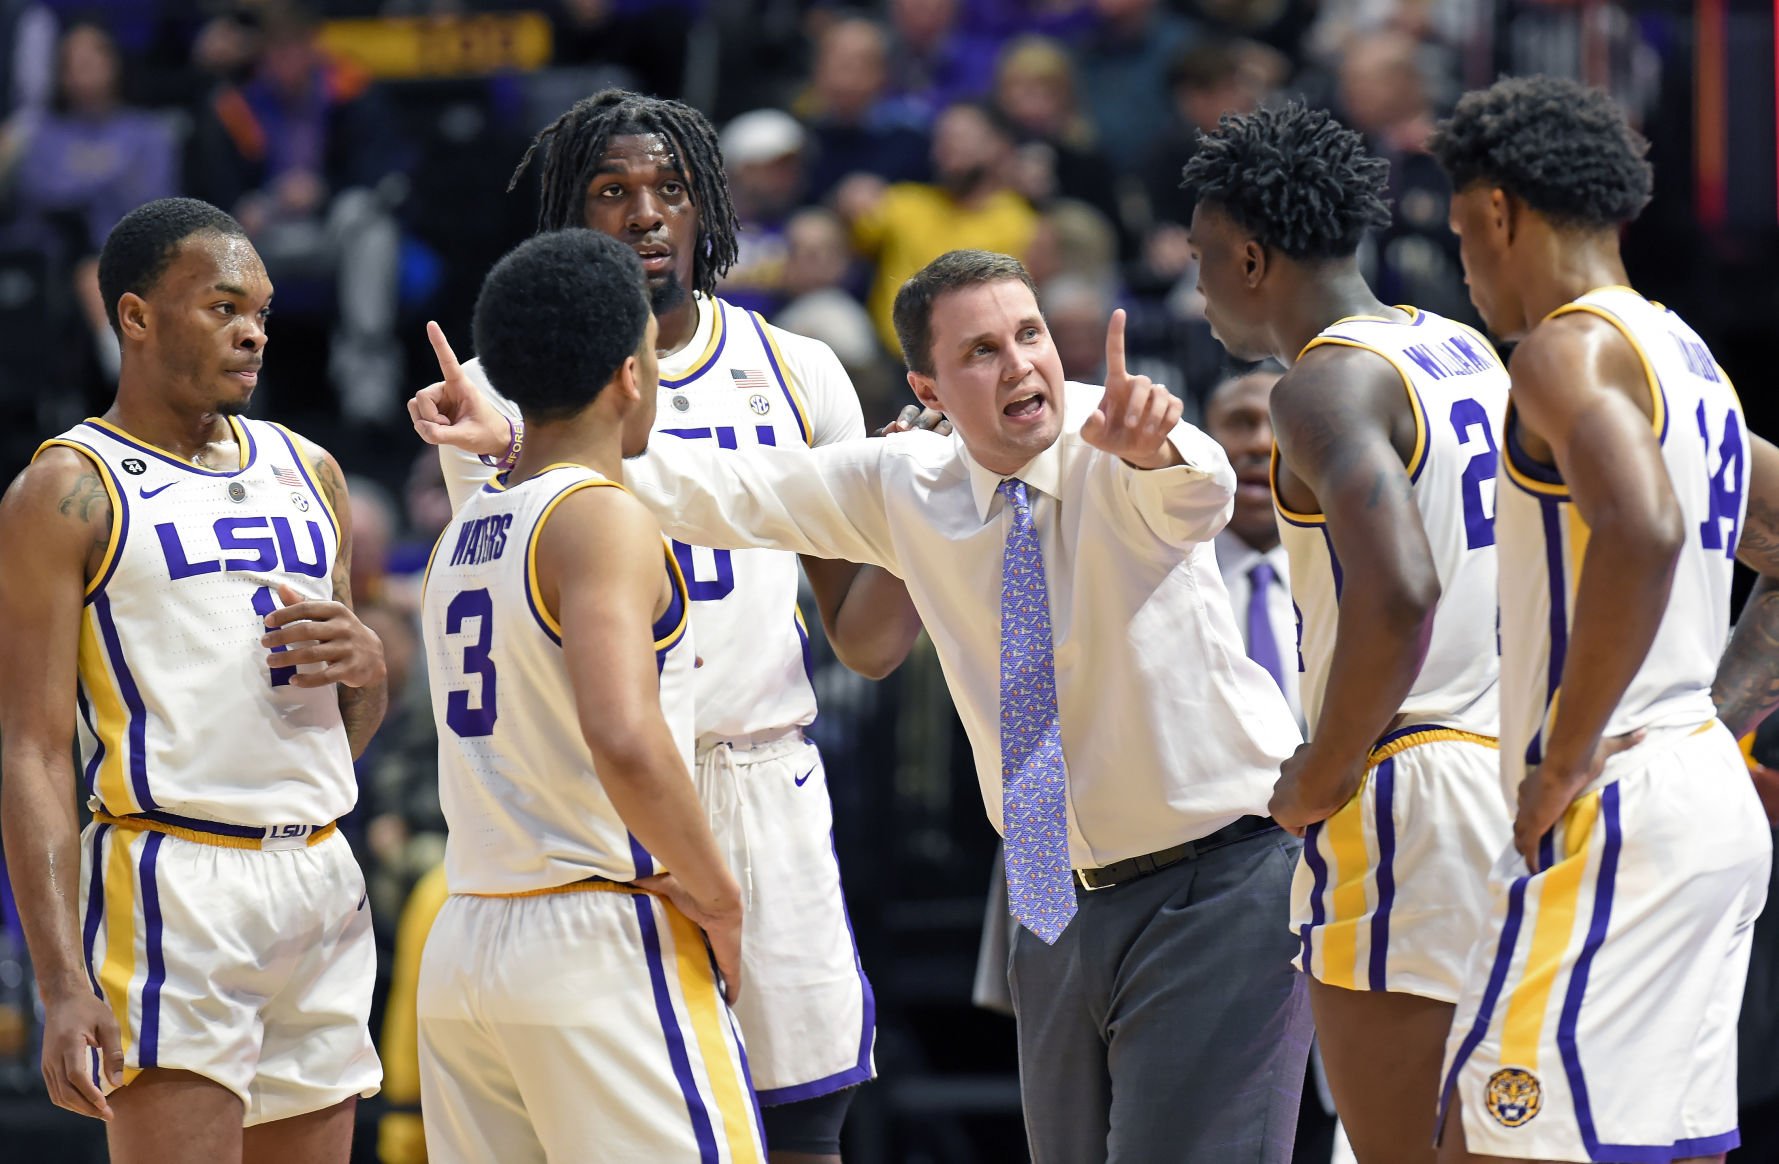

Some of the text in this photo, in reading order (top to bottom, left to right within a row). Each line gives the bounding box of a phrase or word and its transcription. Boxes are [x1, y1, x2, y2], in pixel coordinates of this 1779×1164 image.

[1696, 398, 1744, 560] 14
[154, 516, 328, 580] LSU
[449, 513, 513, 567] WATERS
[250, 586, 298, 687] 1
[446, 586, 497, 738] 3
[269, 824, 307, 839] LSU
